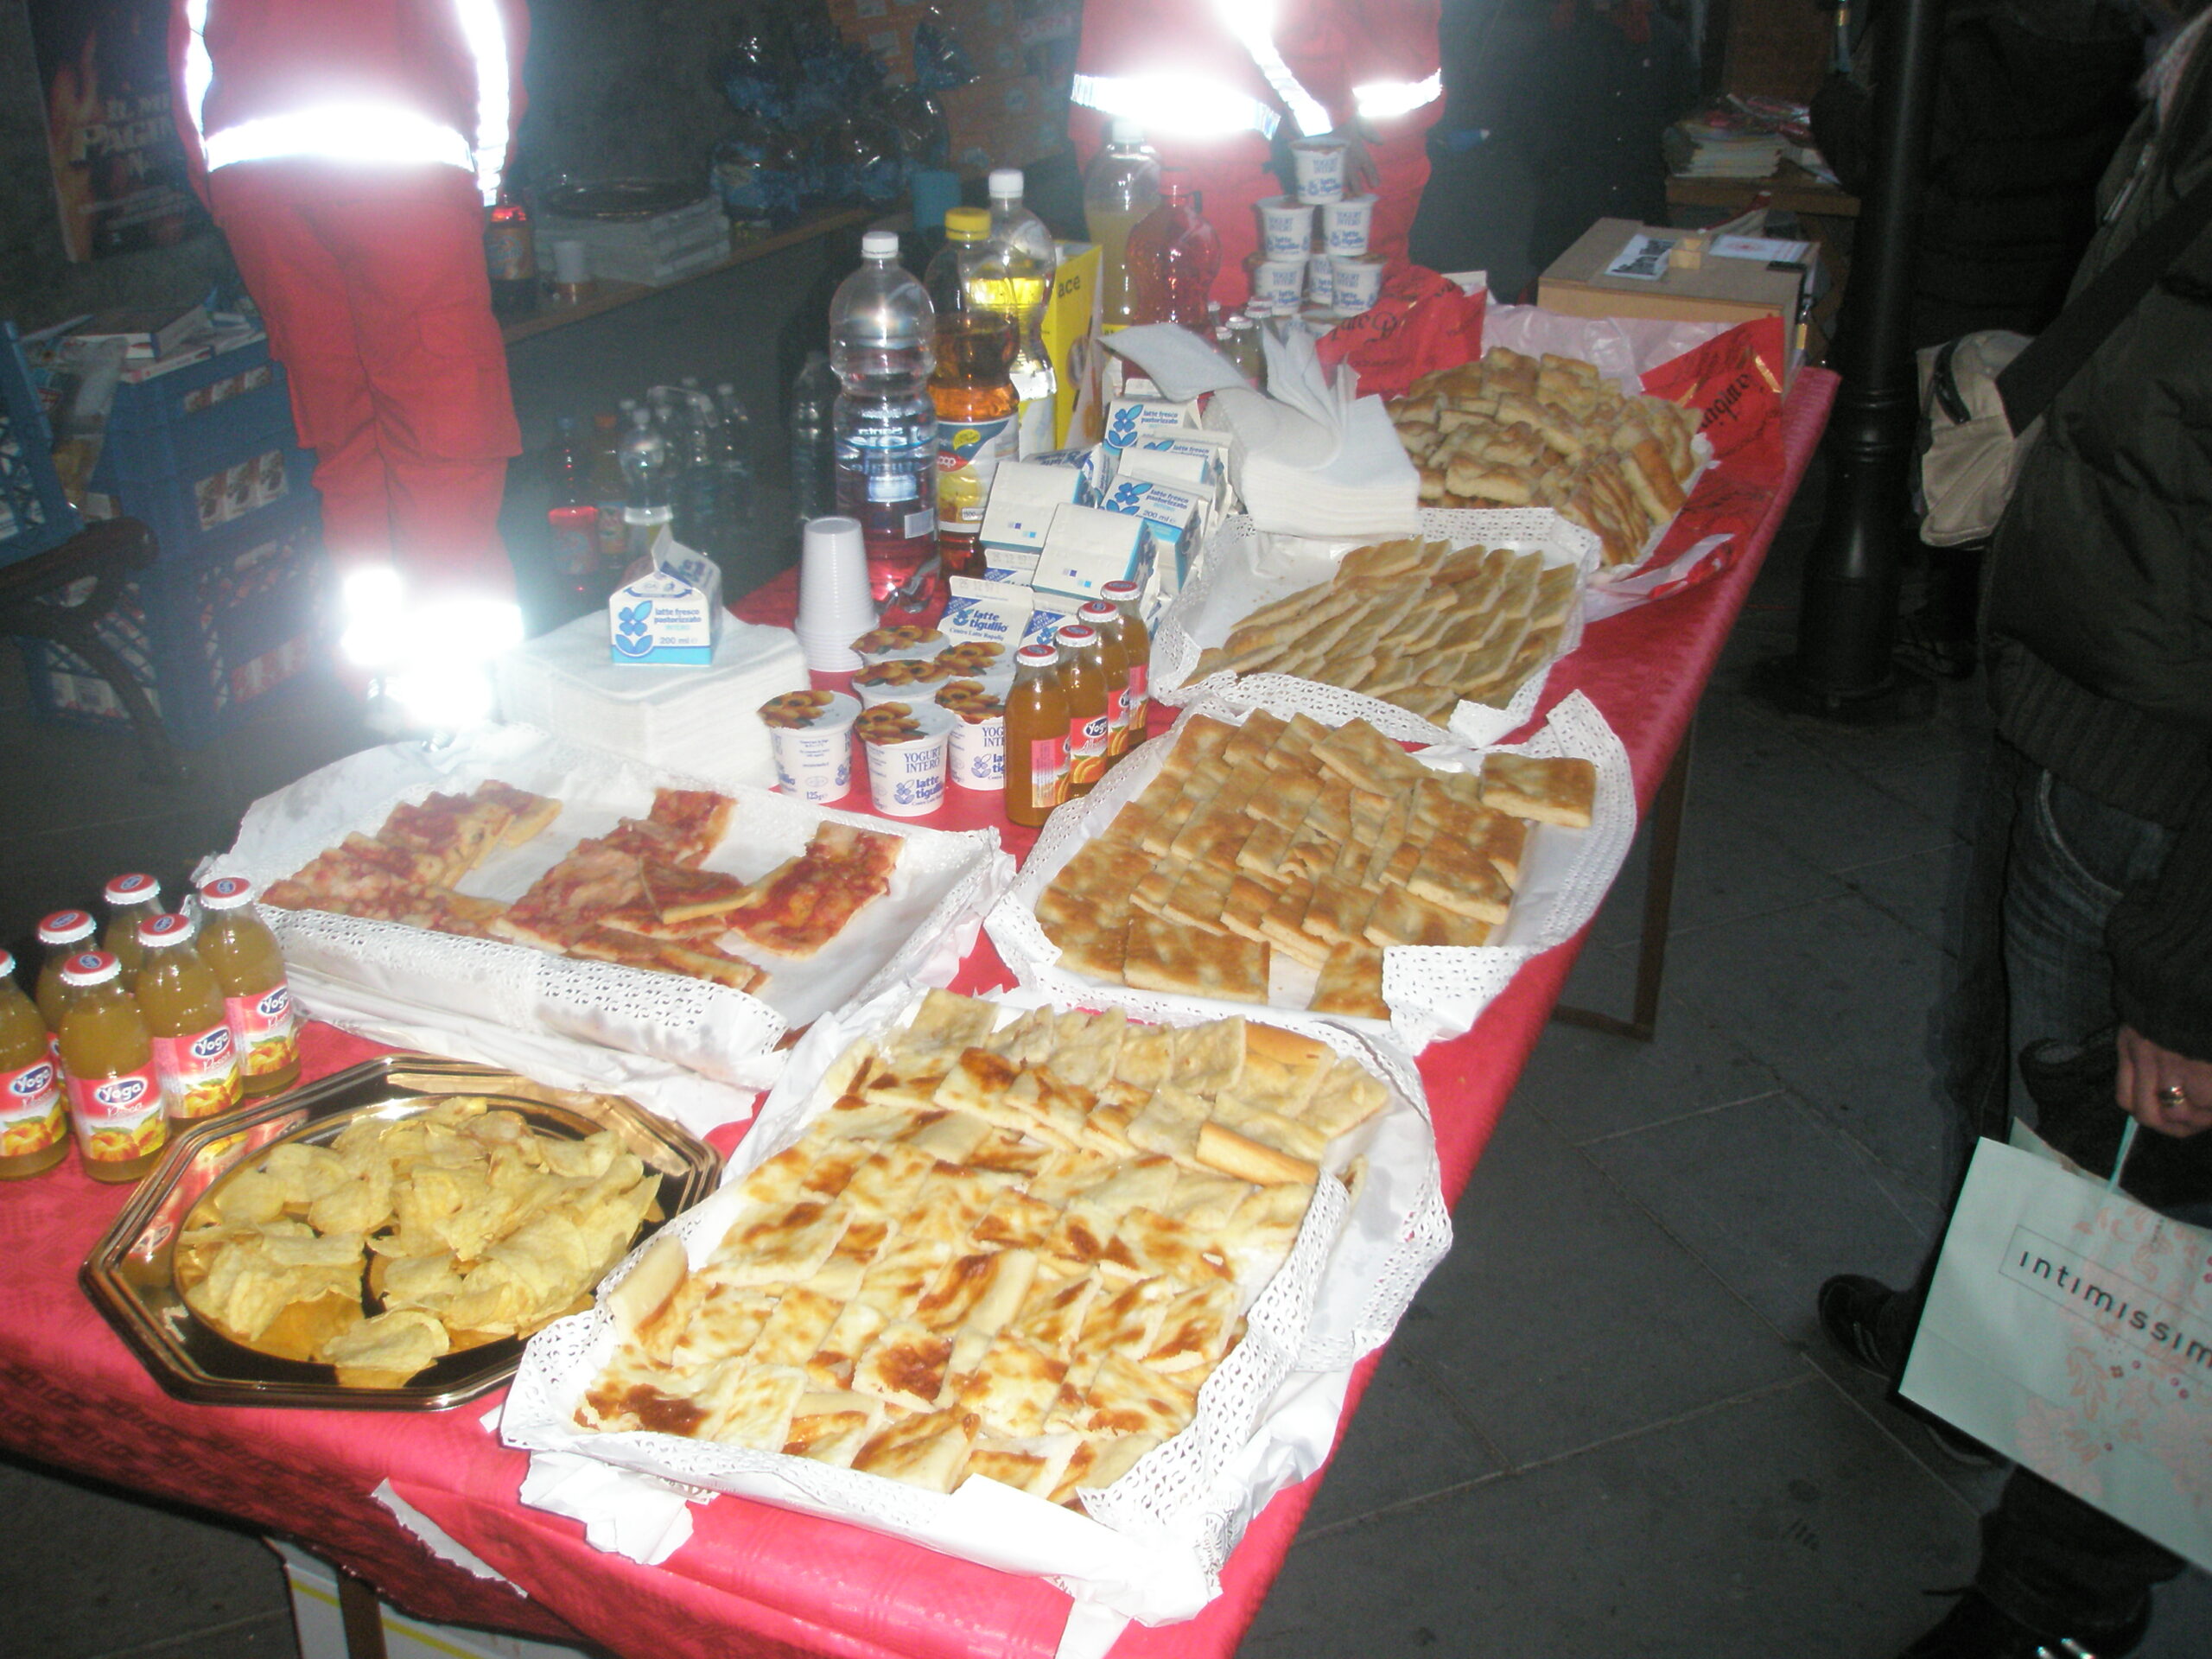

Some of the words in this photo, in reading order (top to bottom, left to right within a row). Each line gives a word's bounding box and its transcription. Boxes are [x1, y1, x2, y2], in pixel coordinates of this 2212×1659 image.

[1057, 275, 1081, 299] ace
[1150, 489, 1166, 498] latte
[1167, 493, 1190, 503] fresco
[973, 609, 1000, 621] latte
[969, 619, 1009, 632] tigullio
[982, 727, 1004, 737] YOG
[1090, 722, 1108, 734] Yog
[904, 746, 942, 763] YOGURT
[906, 759, 940, 773] INTERO
[916, 776, 939, 788] latte
[196, 1032, 228, 1054] Yoga
[16, 1069, 51, 1092] Yoga
[100, 1083, 141, 1102] Yoga
[2018, 1250, 2212, 1369] intimissim
